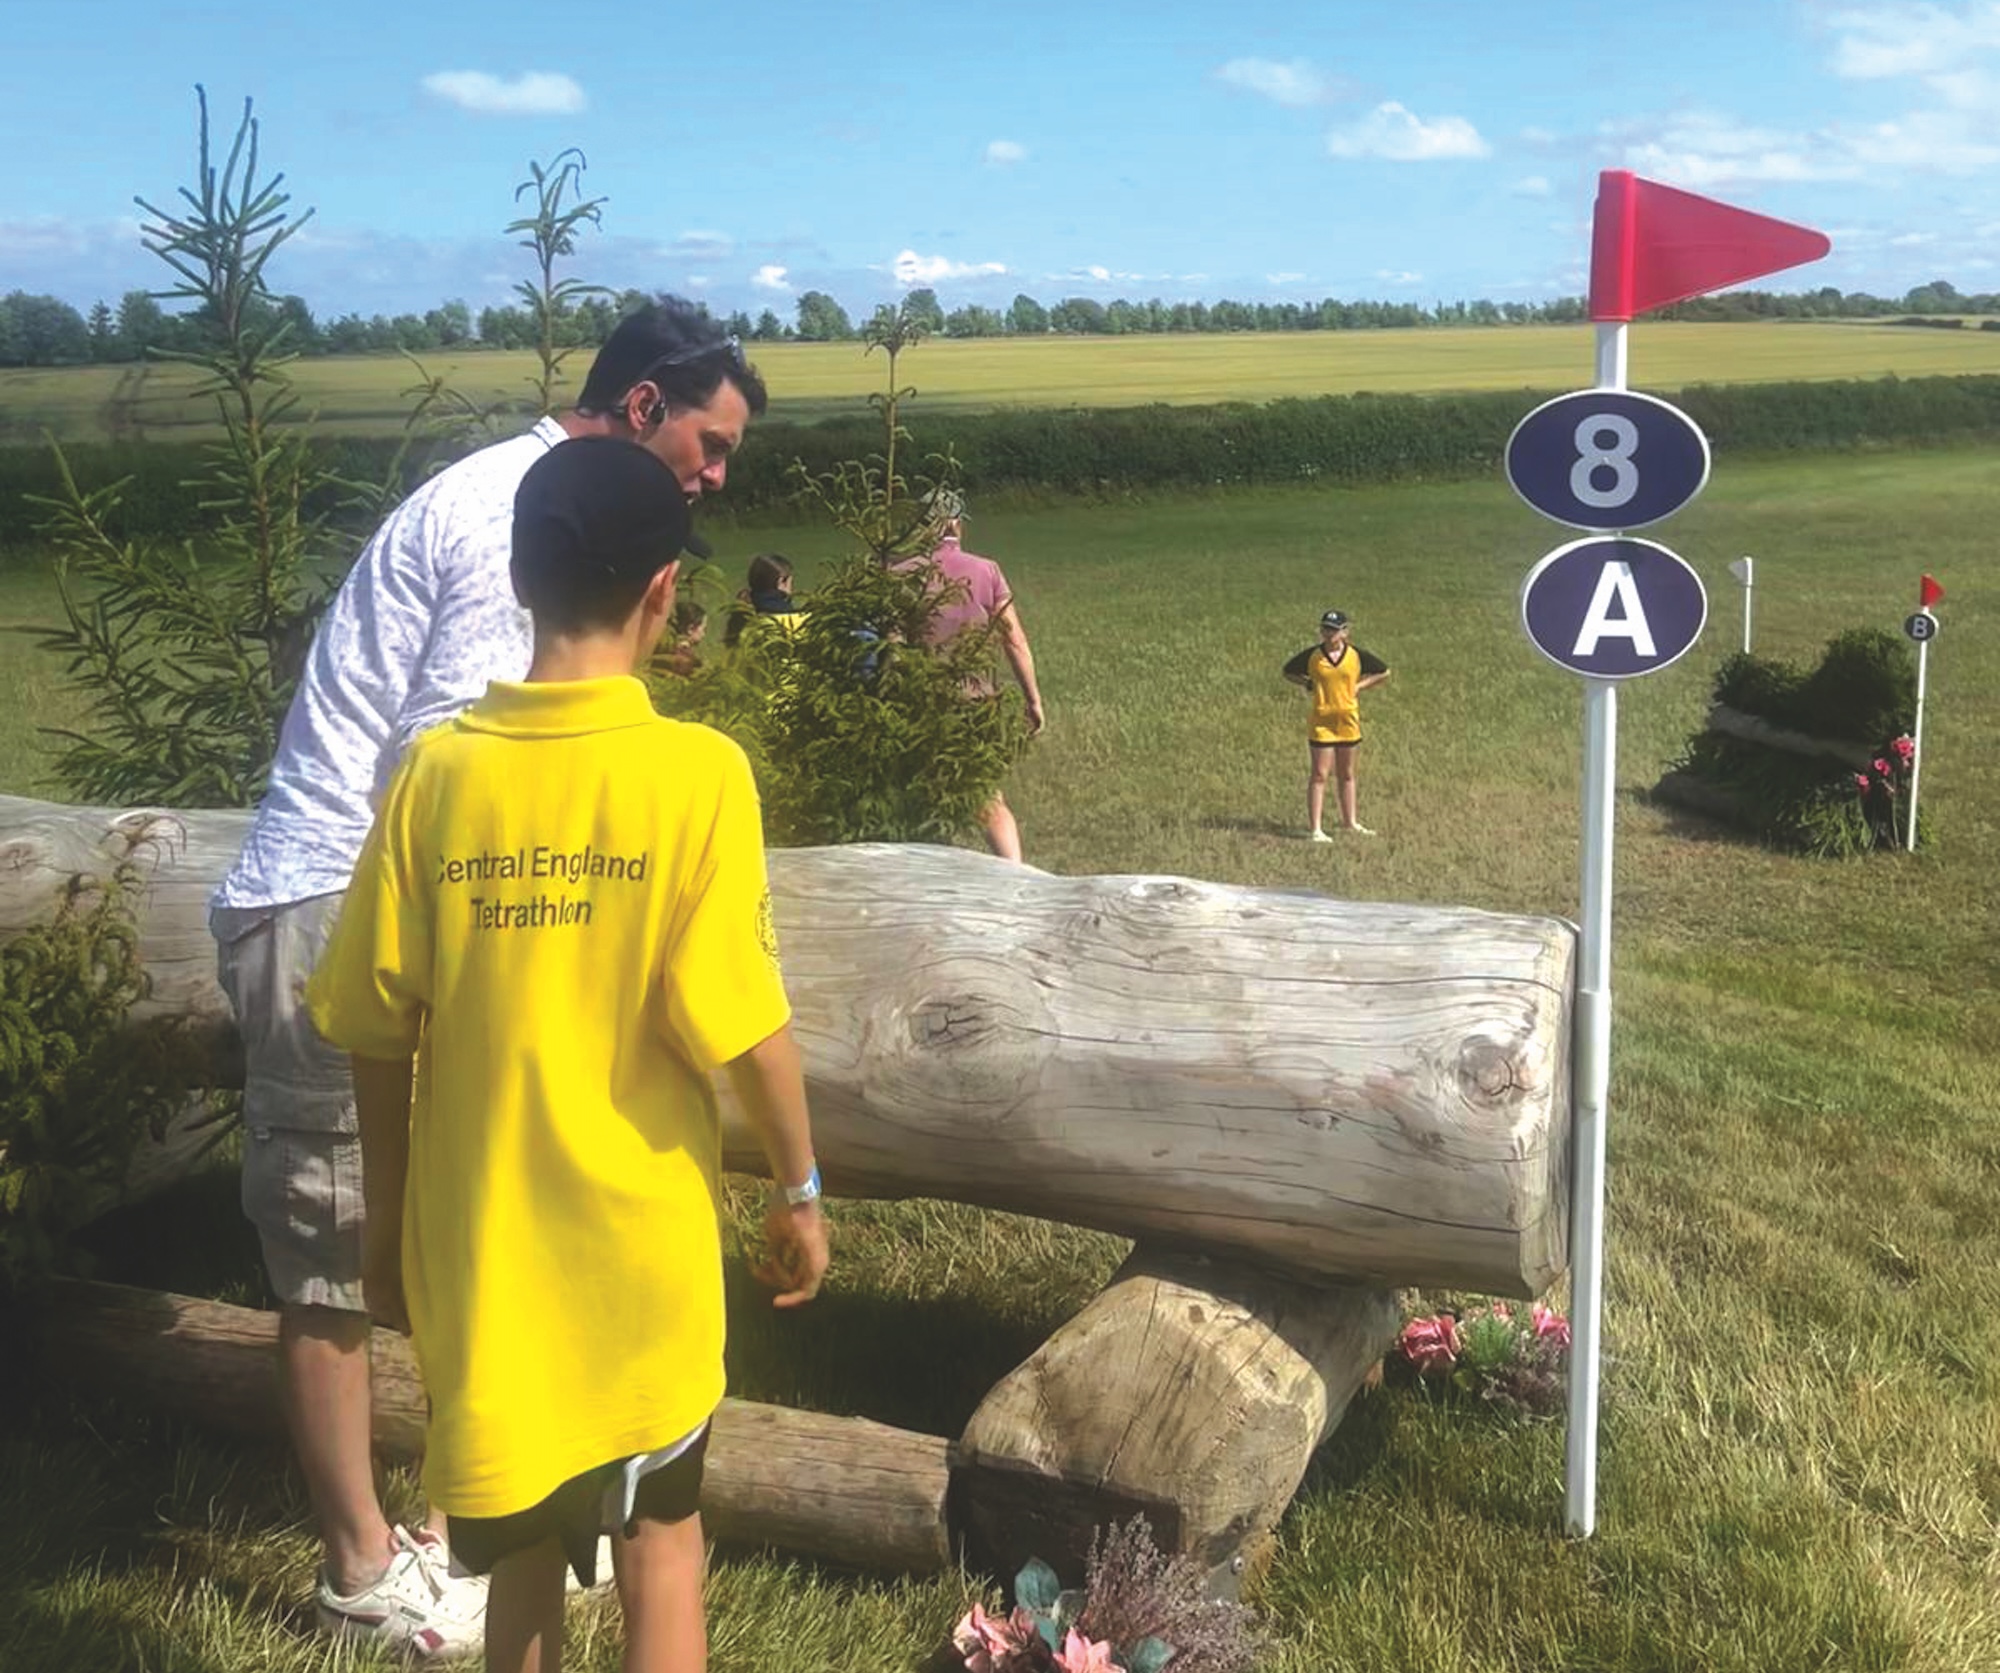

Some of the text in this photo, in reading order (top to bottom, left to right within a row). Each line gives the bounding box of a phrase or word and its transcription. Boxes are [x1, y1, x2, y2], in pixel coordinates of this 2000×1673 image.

[1570, 413, 1639, 508] 8
[1572, 560, 1657, 656] A
[532, 845, 647, 884] England
[471, 895, 592, 929] Tetrathlon
